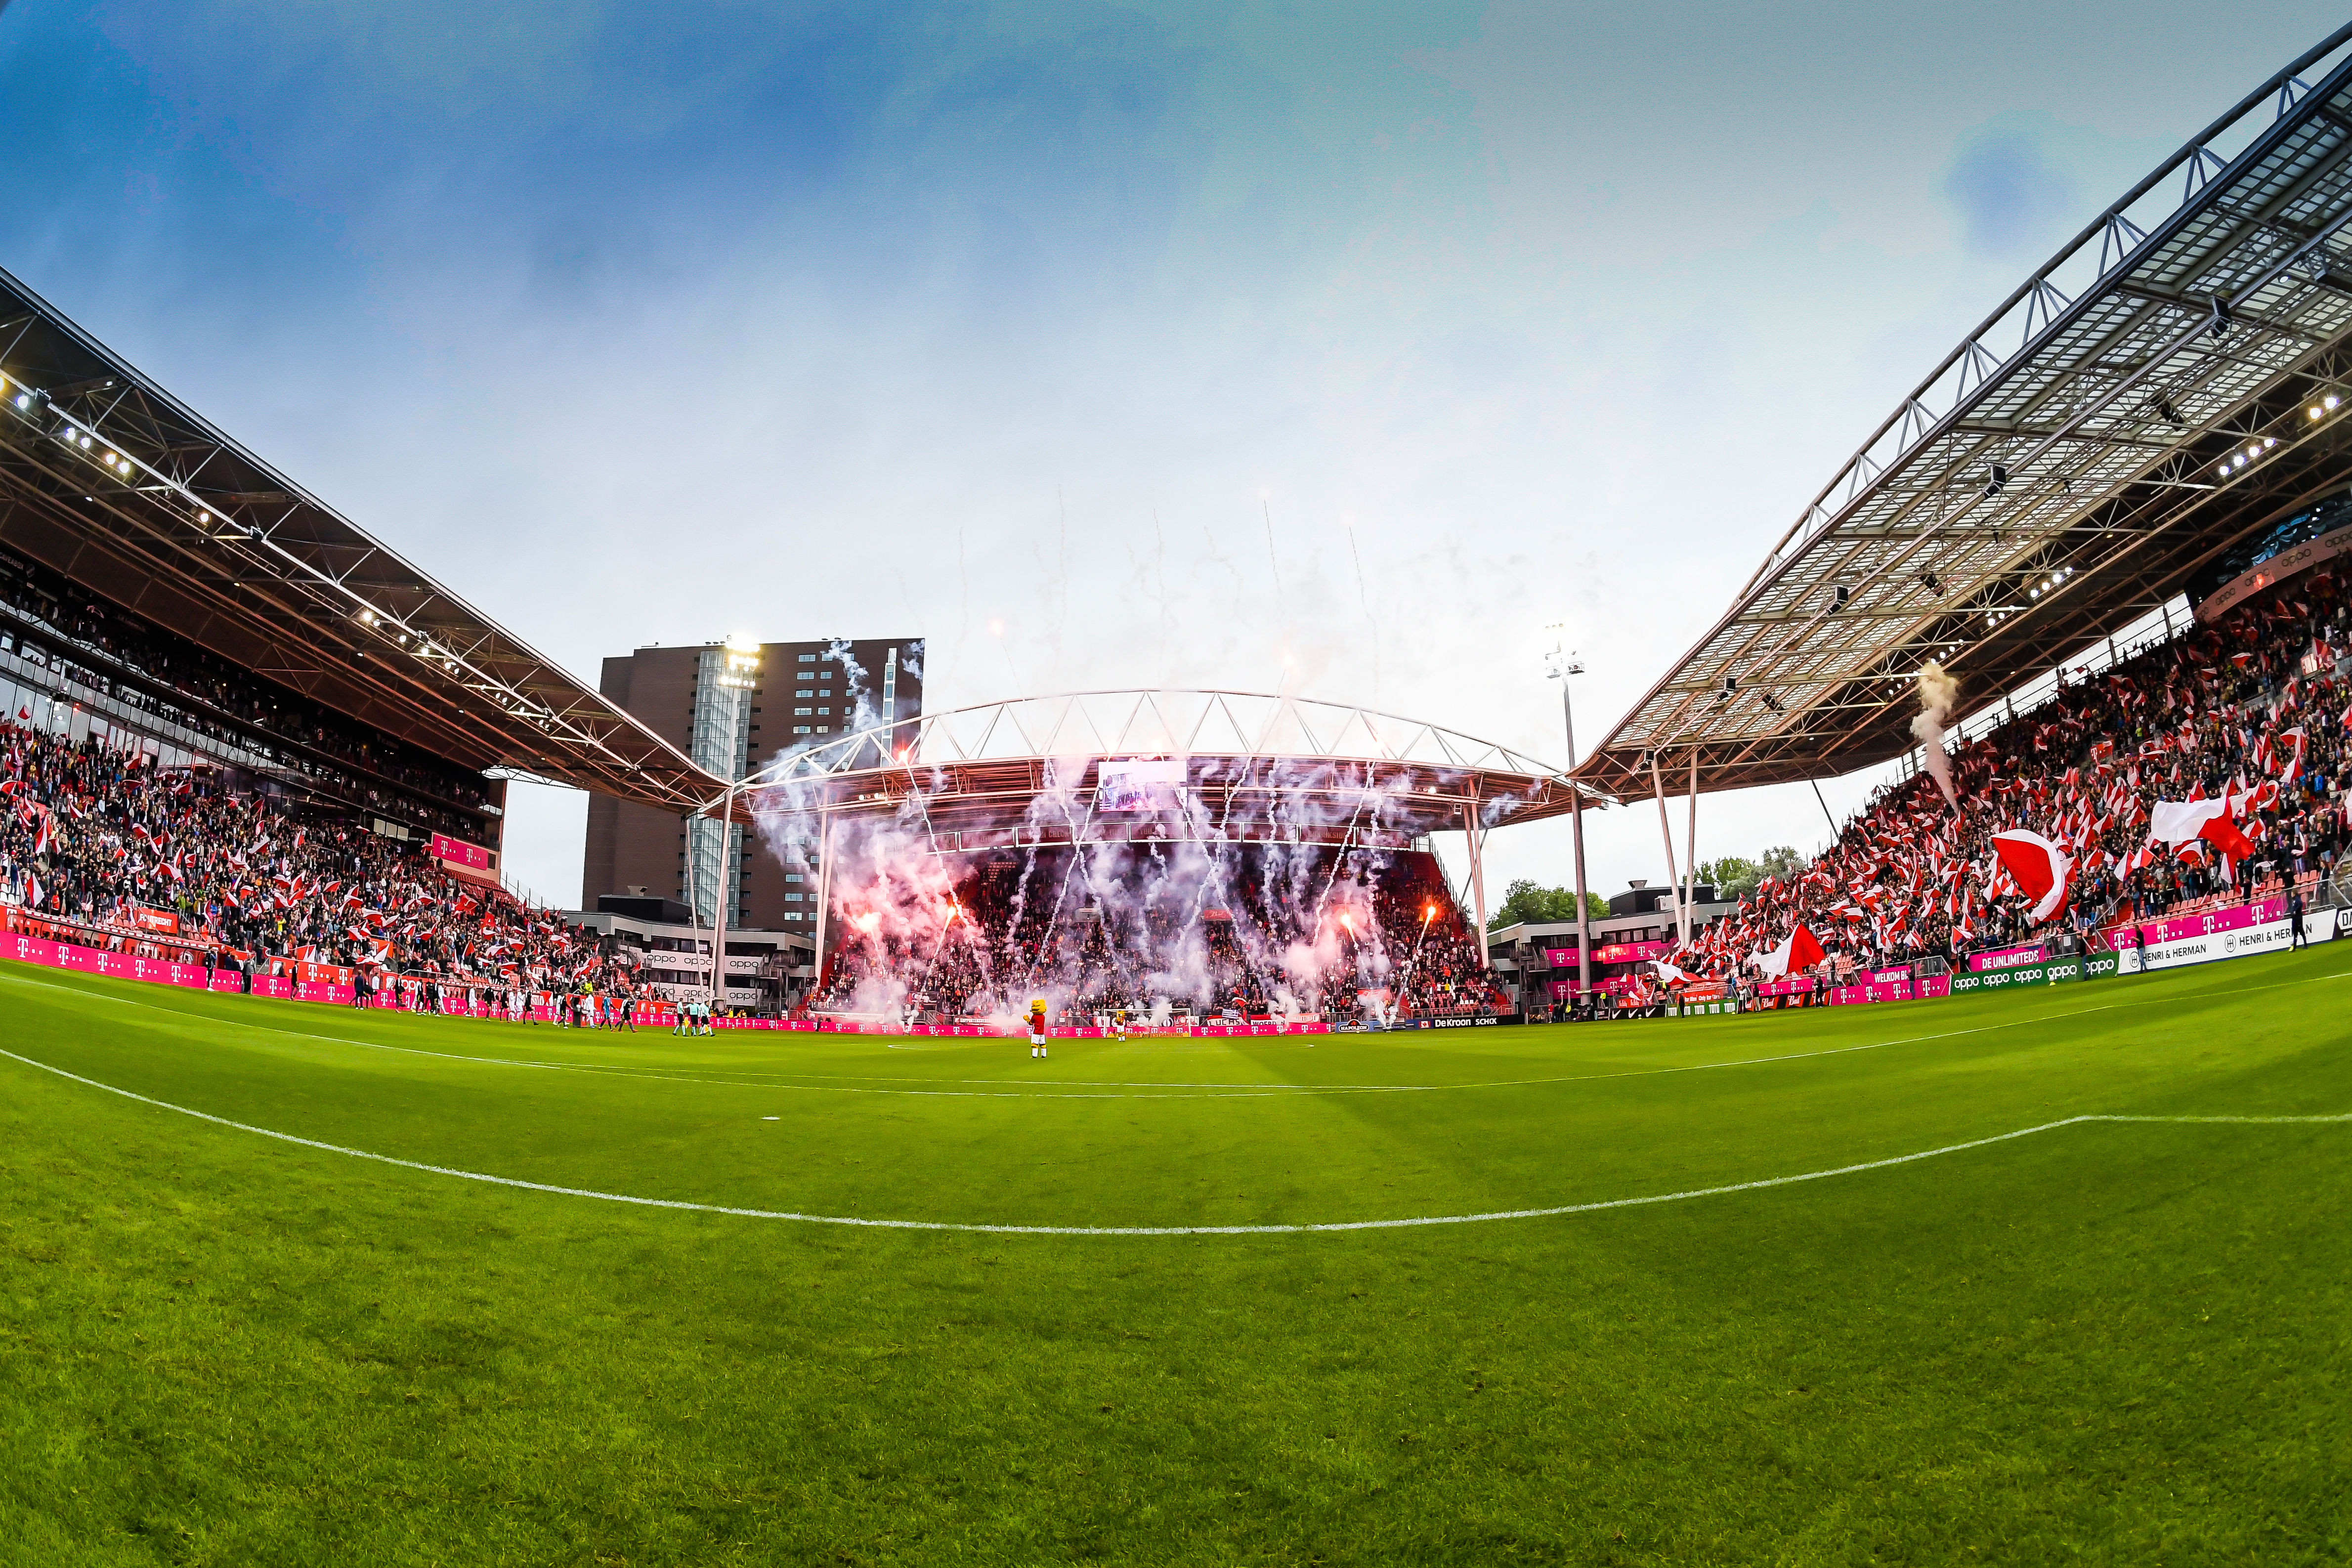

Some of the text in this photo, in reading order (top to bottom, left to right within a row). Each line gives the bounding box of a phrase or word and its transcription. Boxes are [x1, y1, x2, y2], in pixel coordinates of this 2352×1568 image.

[2281, 548, 2311, 567] oppo
[139, 914, 172, 927] FC UTRECHT
[2239, 932, 2264, 947] HENRI
[2266, 932, 2272, 941] &
[2274, 923, 2312, 940] HERN
[647, 954, 677, 963] oppo
[2143, 950, 2164, 962] HENRI
[2166, 950, 2171, 959] &
[2173, 944, 2206, 958] HERMAN
[729, 960, 759, 969] oppo
[1982, 950, 2039, 970] DE UNLIMITEDS
[1875, 972, 1900, 983] WELKOM
[2014, 969, 2042, 983] oppo
[2047, 965, 2077, 979] oppo
[1954, 977, 1979, 990] oppo
[1983, 973, 2010, 987] oppo
[729, 992, 758, 1001] oppo
[1762, 998, 1774, 1008] Bud
[1788, 995, 1800, 1005] Bud
